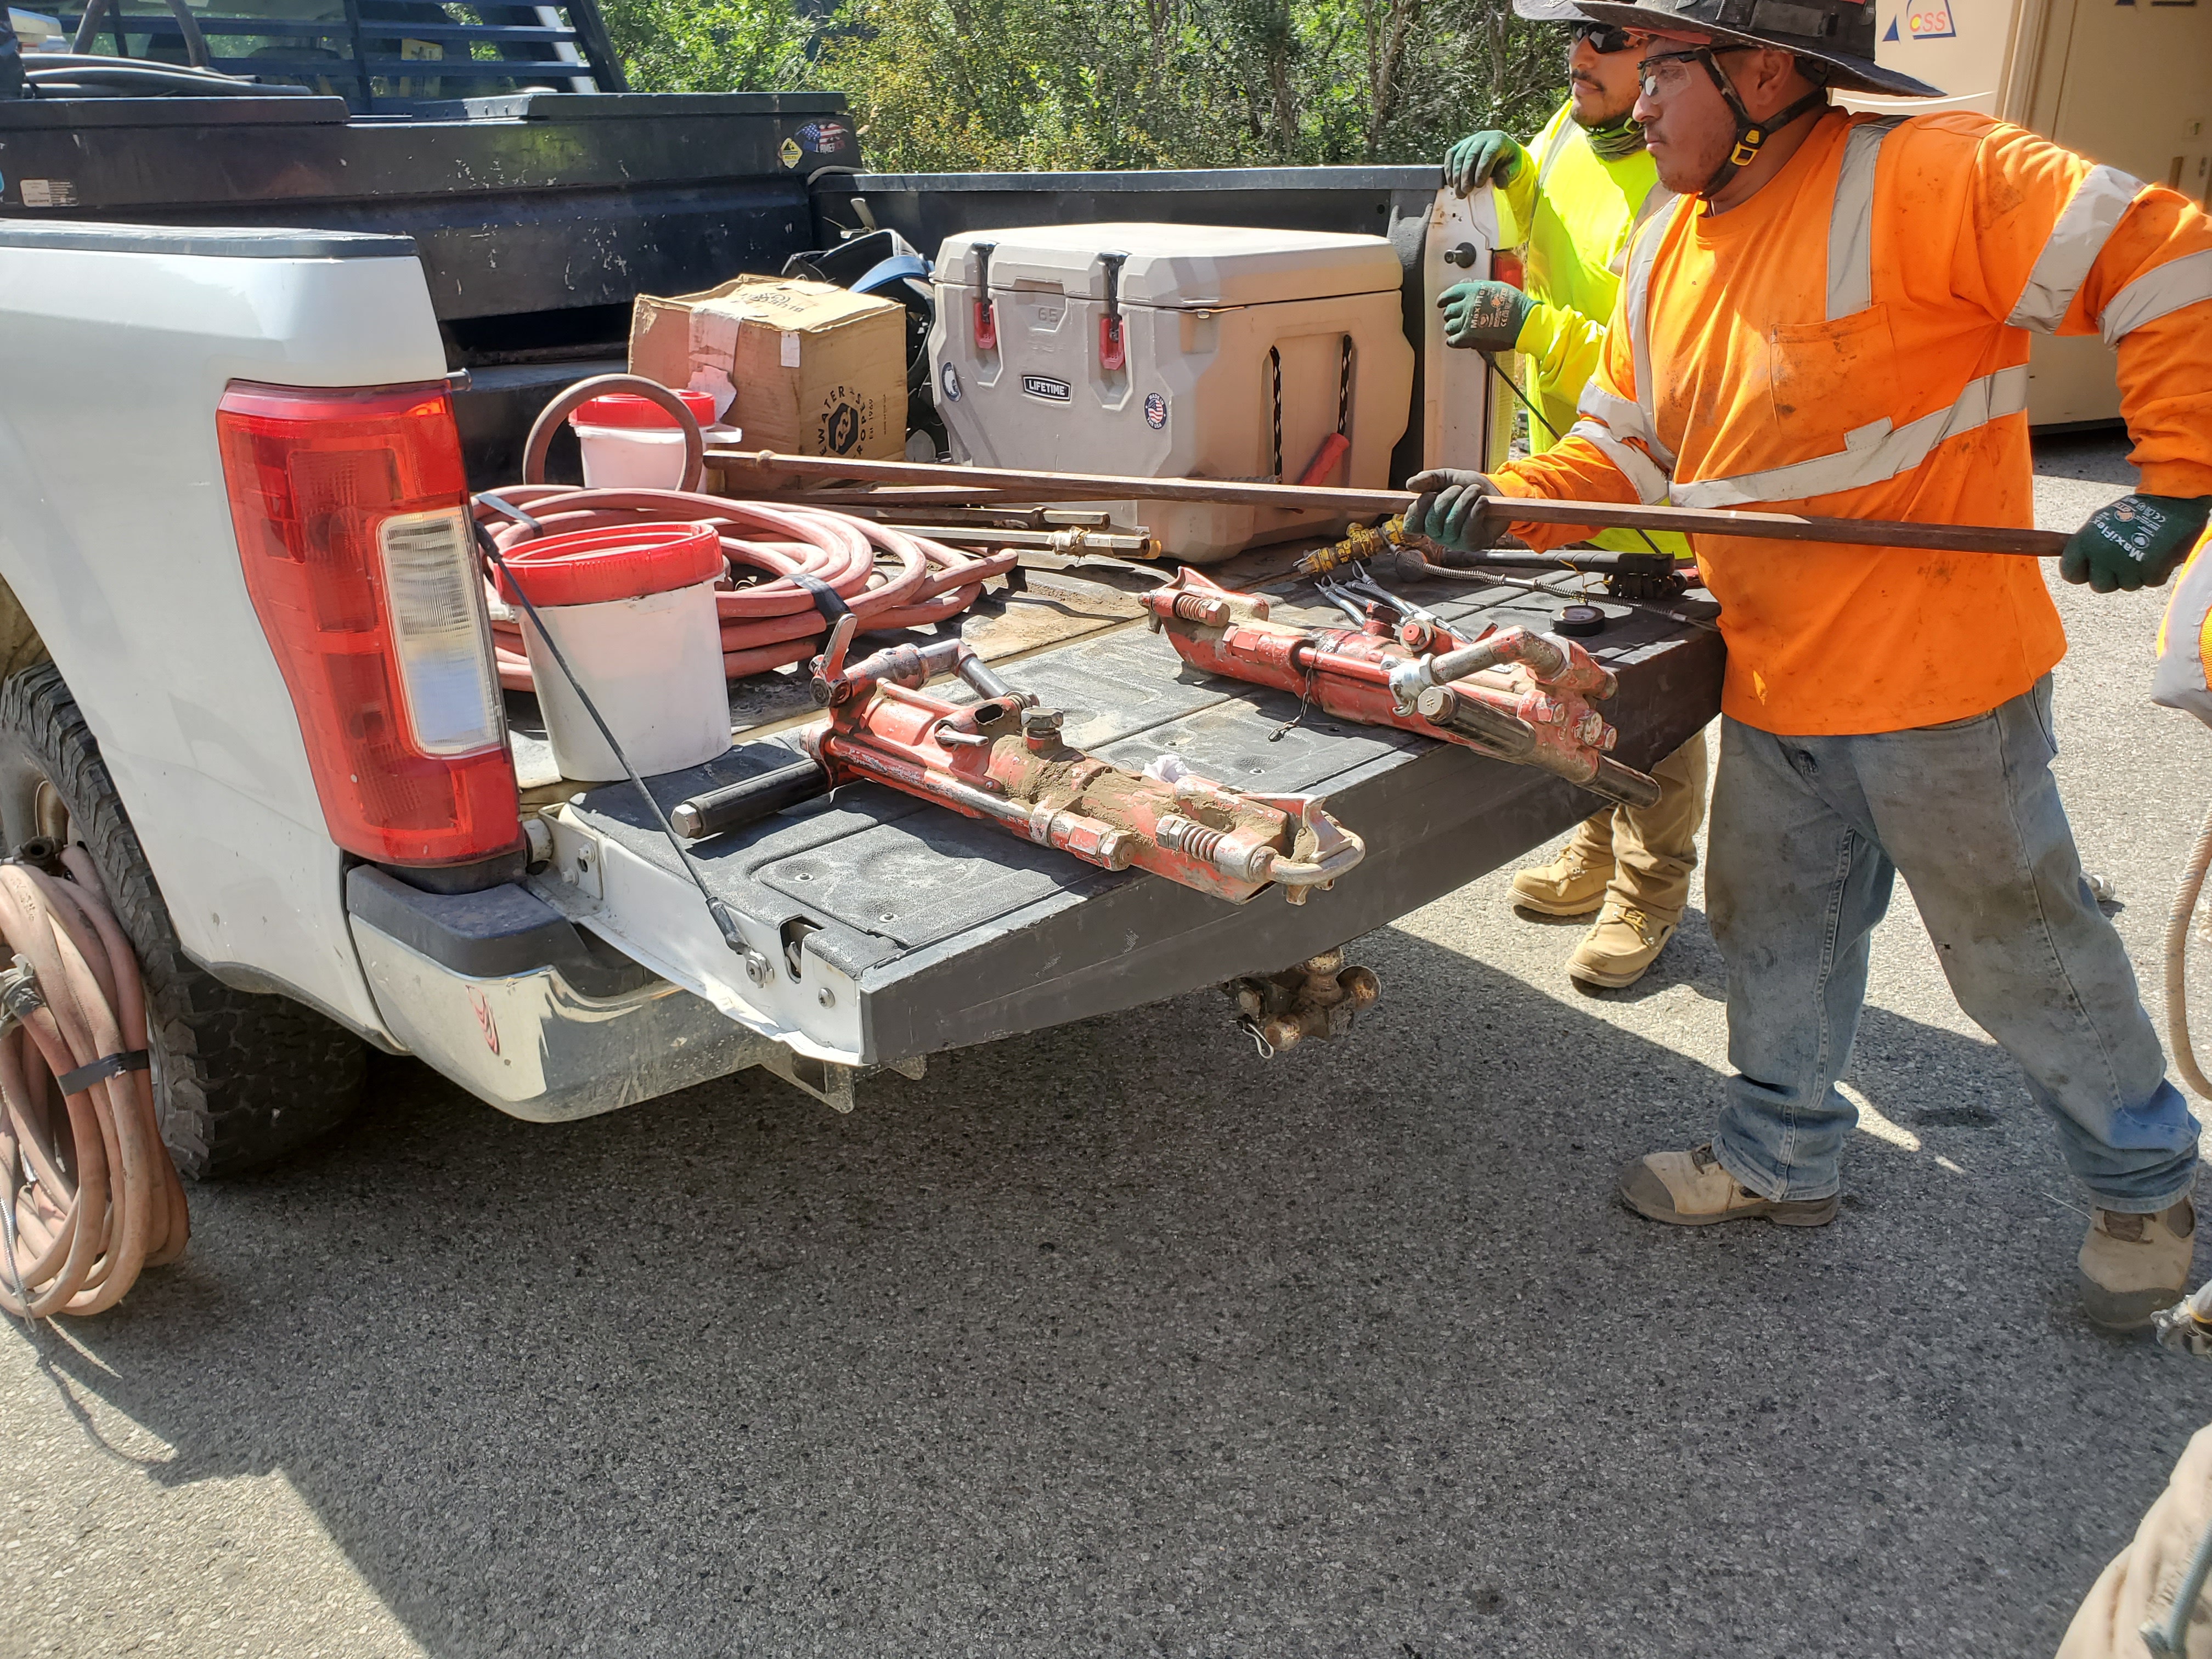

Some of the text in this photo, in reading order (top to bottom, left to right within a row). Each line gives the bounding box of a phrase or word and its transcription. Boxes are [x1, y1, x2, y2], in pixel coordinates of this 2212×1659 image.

[1909, 10, 1946, 33] CSS
[1038, 307, 1058, 323] 65
[1029, 380, 1065, 396] LIFETIME
[817, 386, 845, 456] EWATER
[855, 393, 867, 455] ROPES
[2089, 518, 2146, 562] MaxiFlex
